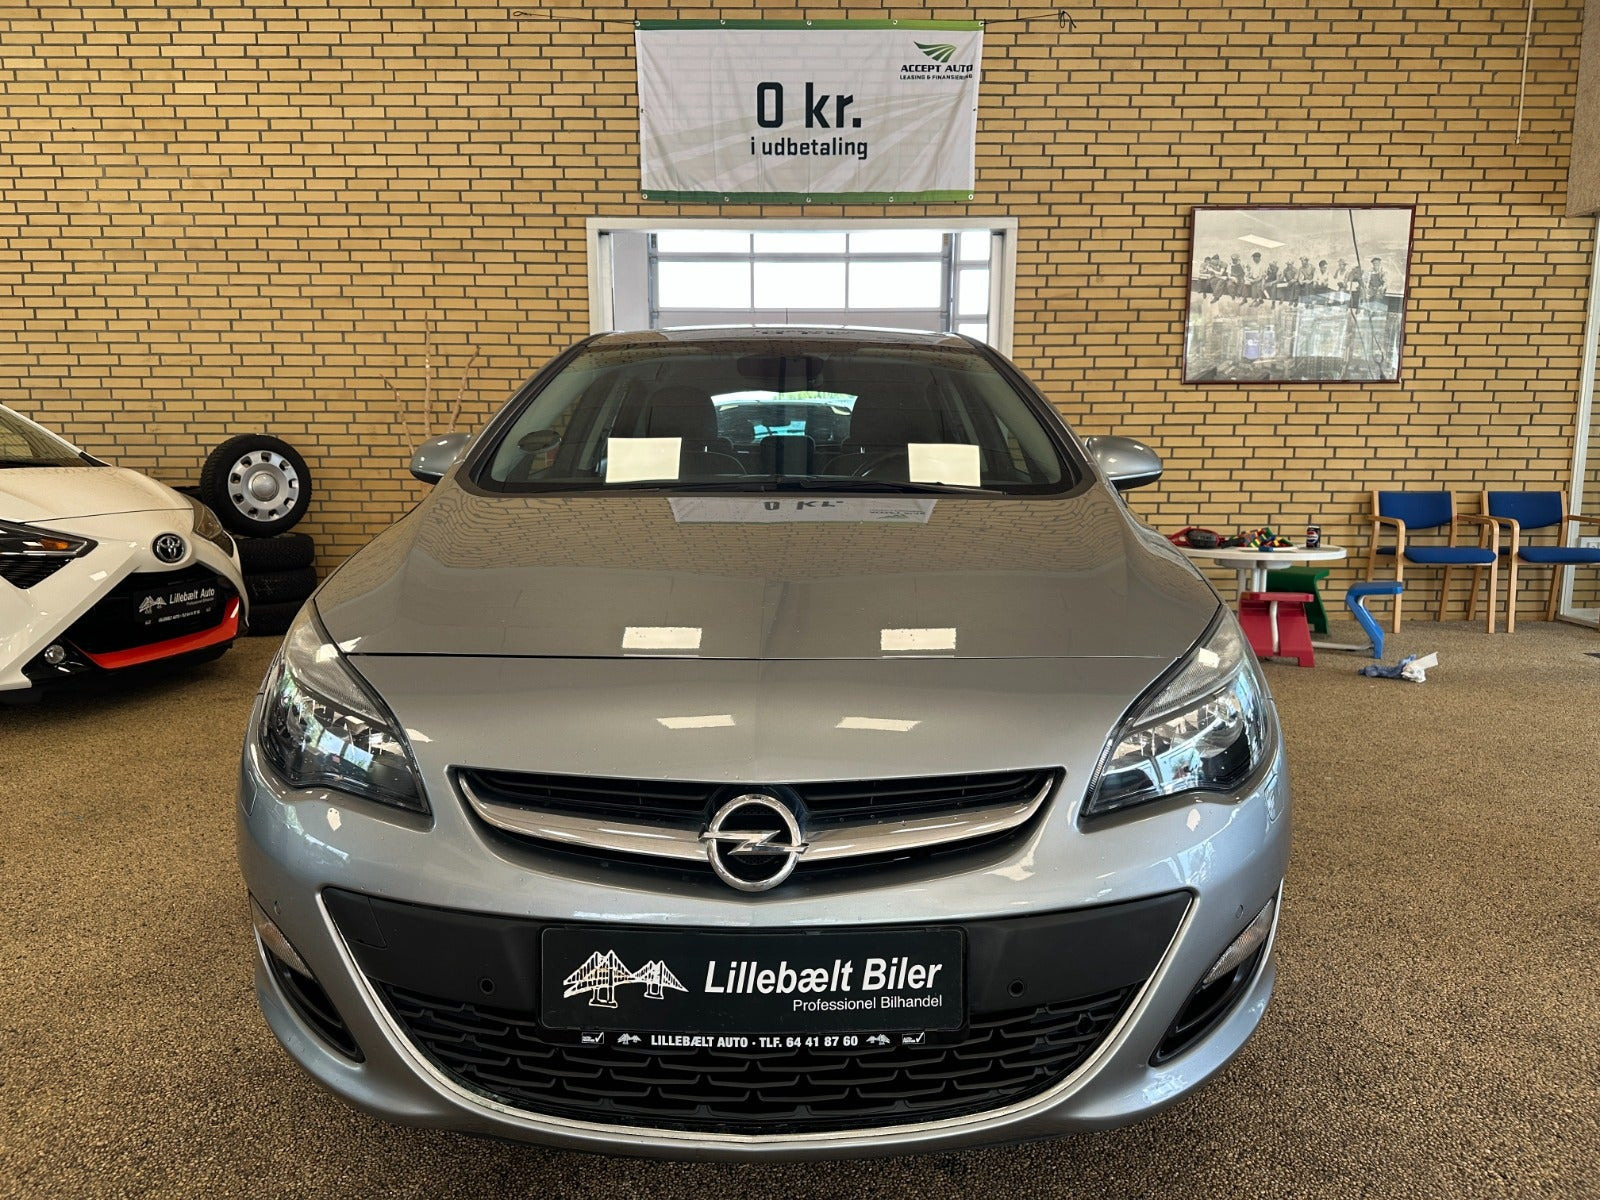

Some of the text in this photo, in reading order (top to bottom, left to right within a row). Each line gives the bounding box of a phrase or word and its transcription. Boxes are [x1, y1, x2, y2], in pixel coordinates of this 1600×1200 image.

[901, 64, 973, 73] ACCEPT AUTO
[805, 82, 862, 128] kr.
[751, 136, 868, 160] i udbetaling
[200, 588, 215, 598] Auto
[704, 956, 943, 994] Lillebælt Biler
[793, 994, 943, 1011] Professionel Bilhandel
[651, 1034, 859, 1048] LILLEBÆLT AUTO TLF. 64 41 87 60
